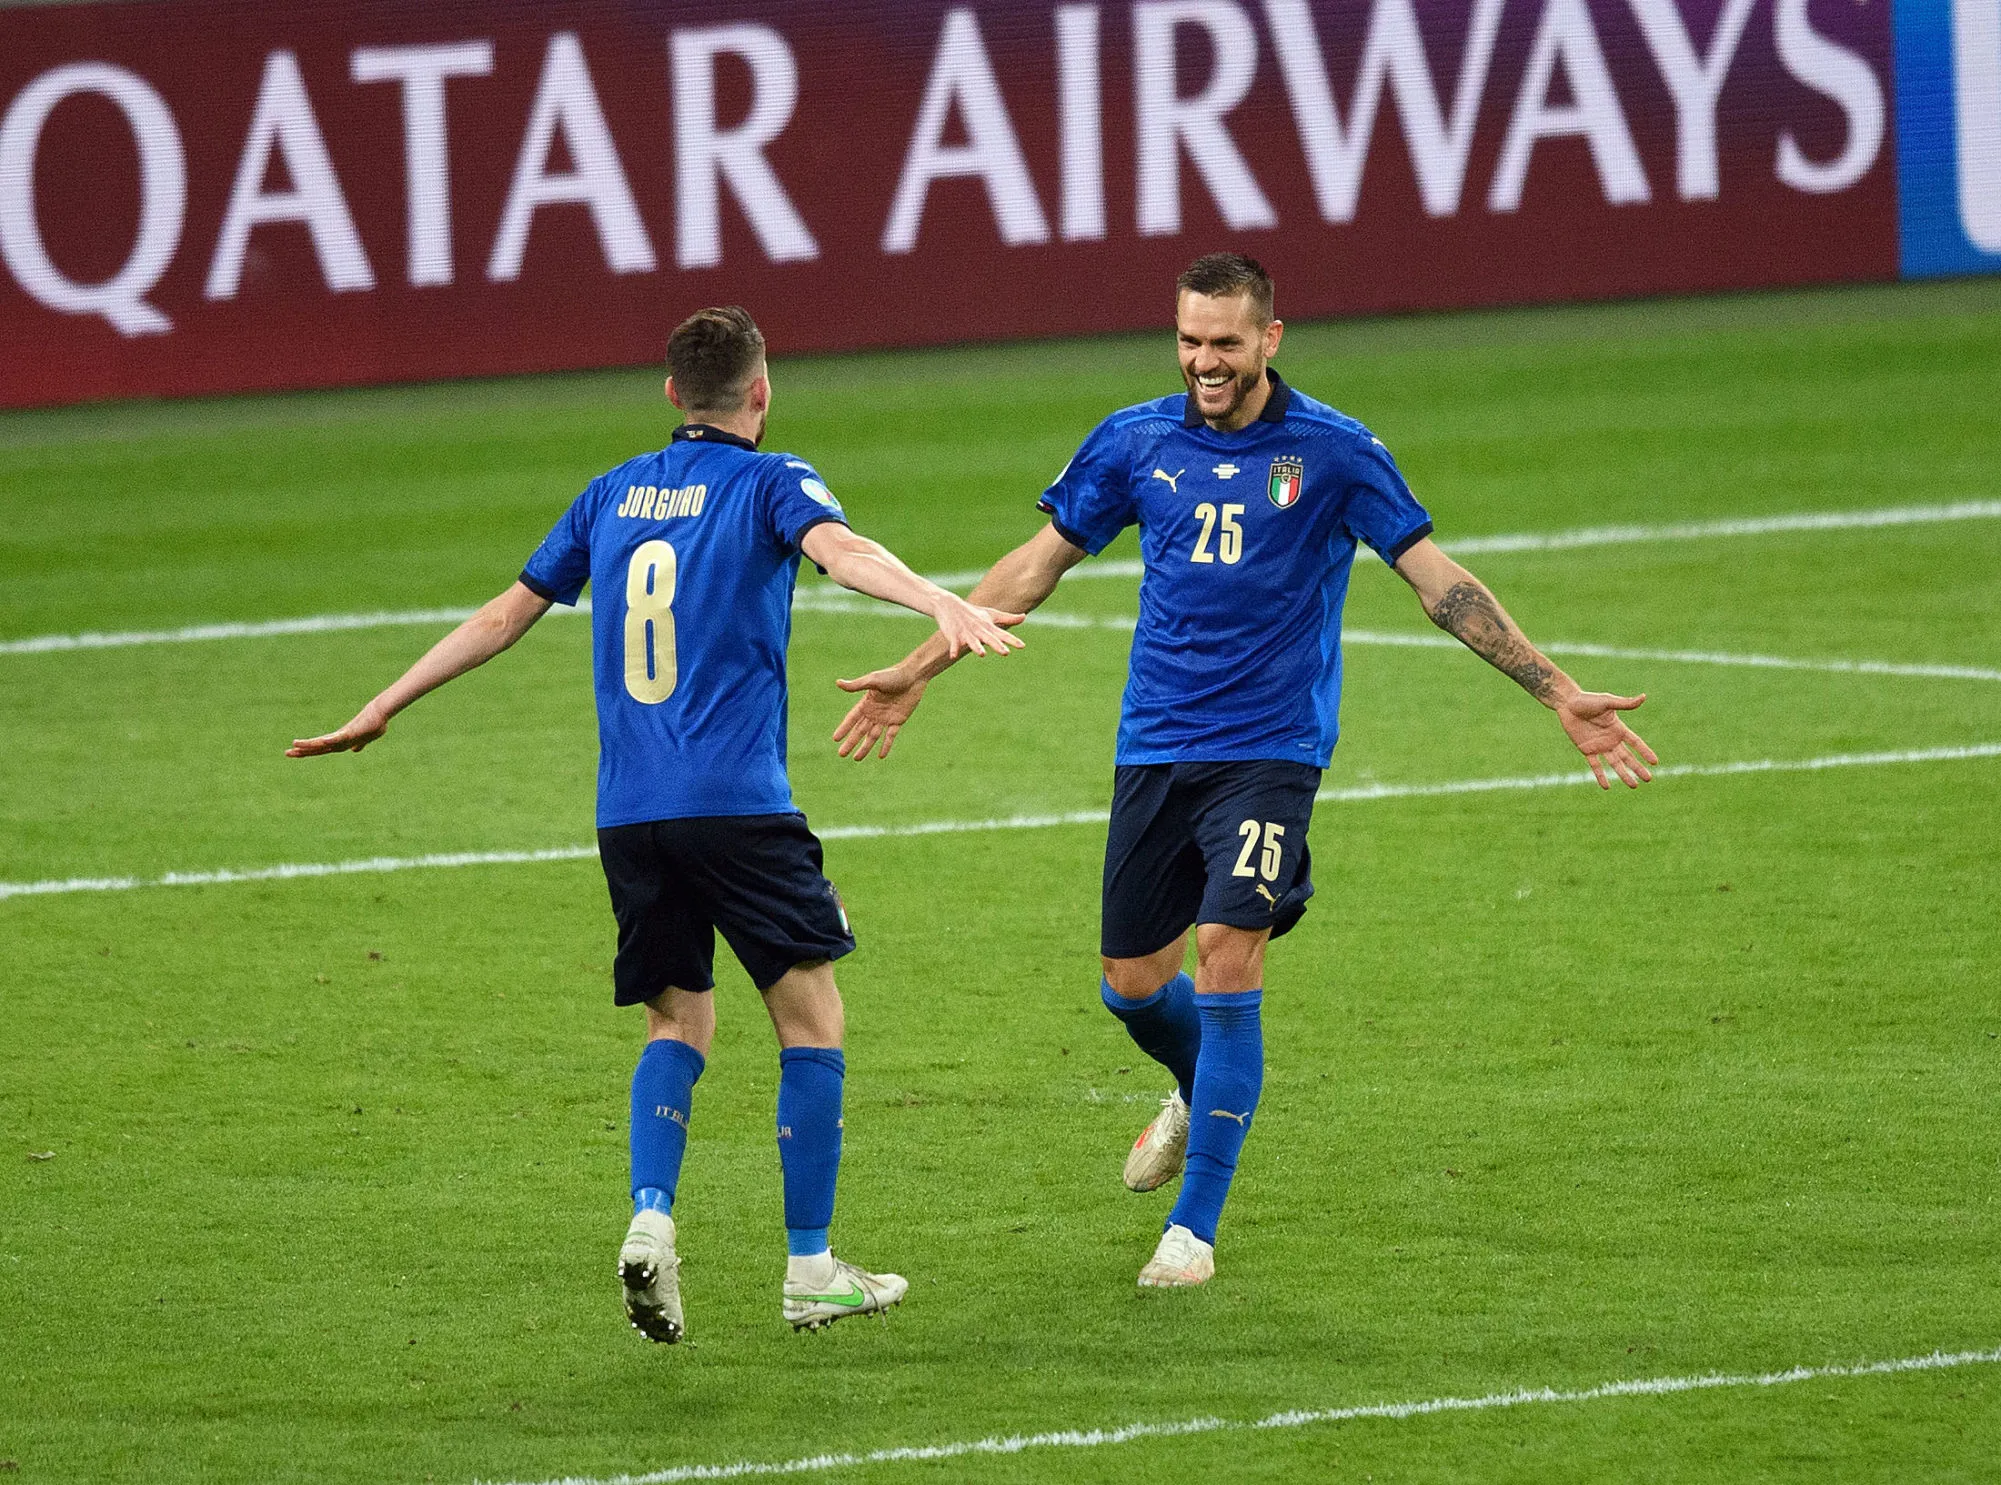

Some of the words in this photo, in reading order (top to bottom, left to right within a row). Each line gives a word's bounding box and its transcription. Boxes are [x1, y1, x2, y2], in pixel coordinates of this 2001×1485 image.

[0, 22, 820, 337] QATAR
[880, 0, 1885, 253] AIRWAYS
[1273, 466, 1300, 474] ITALIA
[1190, 502, 1245, 564] 25
[624, 540, 677, 704] 8
[1231, 819, 1285, 882] 25
